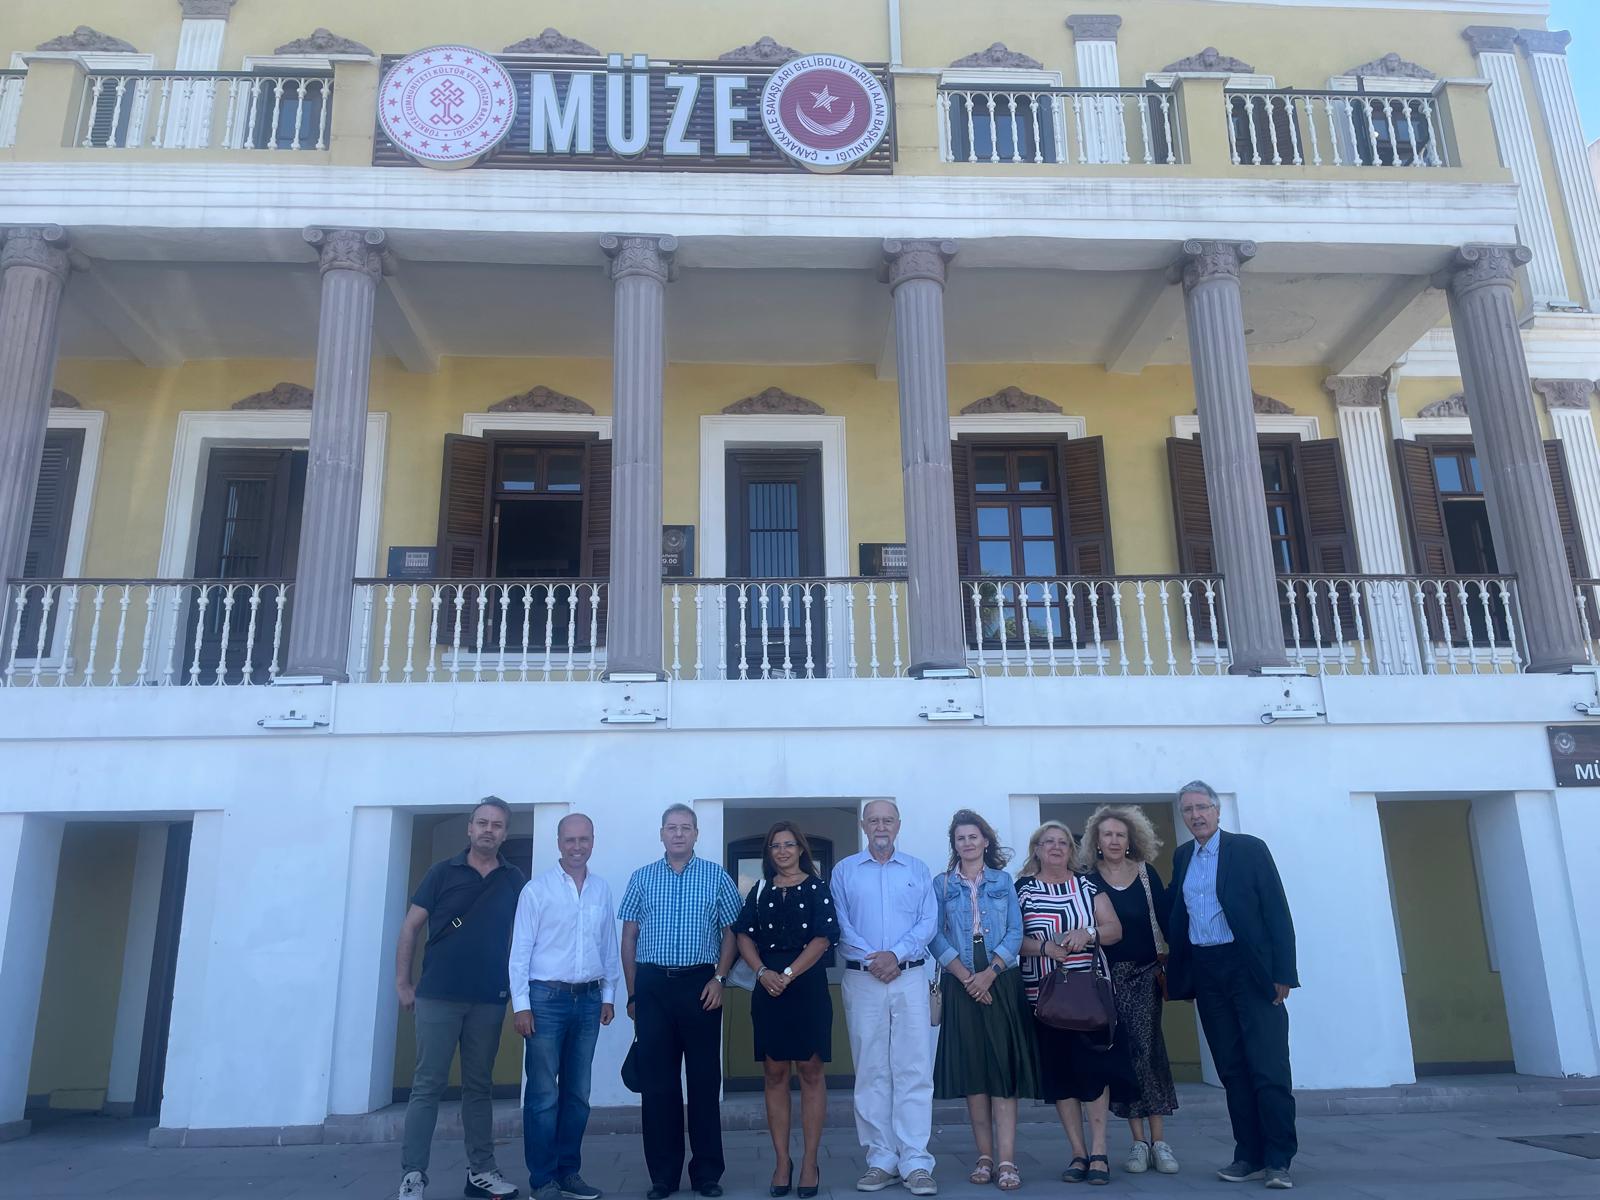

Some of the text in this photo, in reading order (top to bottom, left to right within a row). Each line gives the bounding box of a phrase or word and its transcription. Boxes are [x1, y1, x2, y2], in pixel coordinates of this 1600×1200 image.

[406, 67, 488, 137] TÜRKİYE CUMHURİYETİ KÜLTÜR VE TURİZM BAKANLIĞI
[530, 53, 750, 155] MÜZE
[767, 55, 885, 161] ÇANAKKALE SAVAŞLARI GELİBOLU TARİHİ ALAN BAŞKANLIĞI
